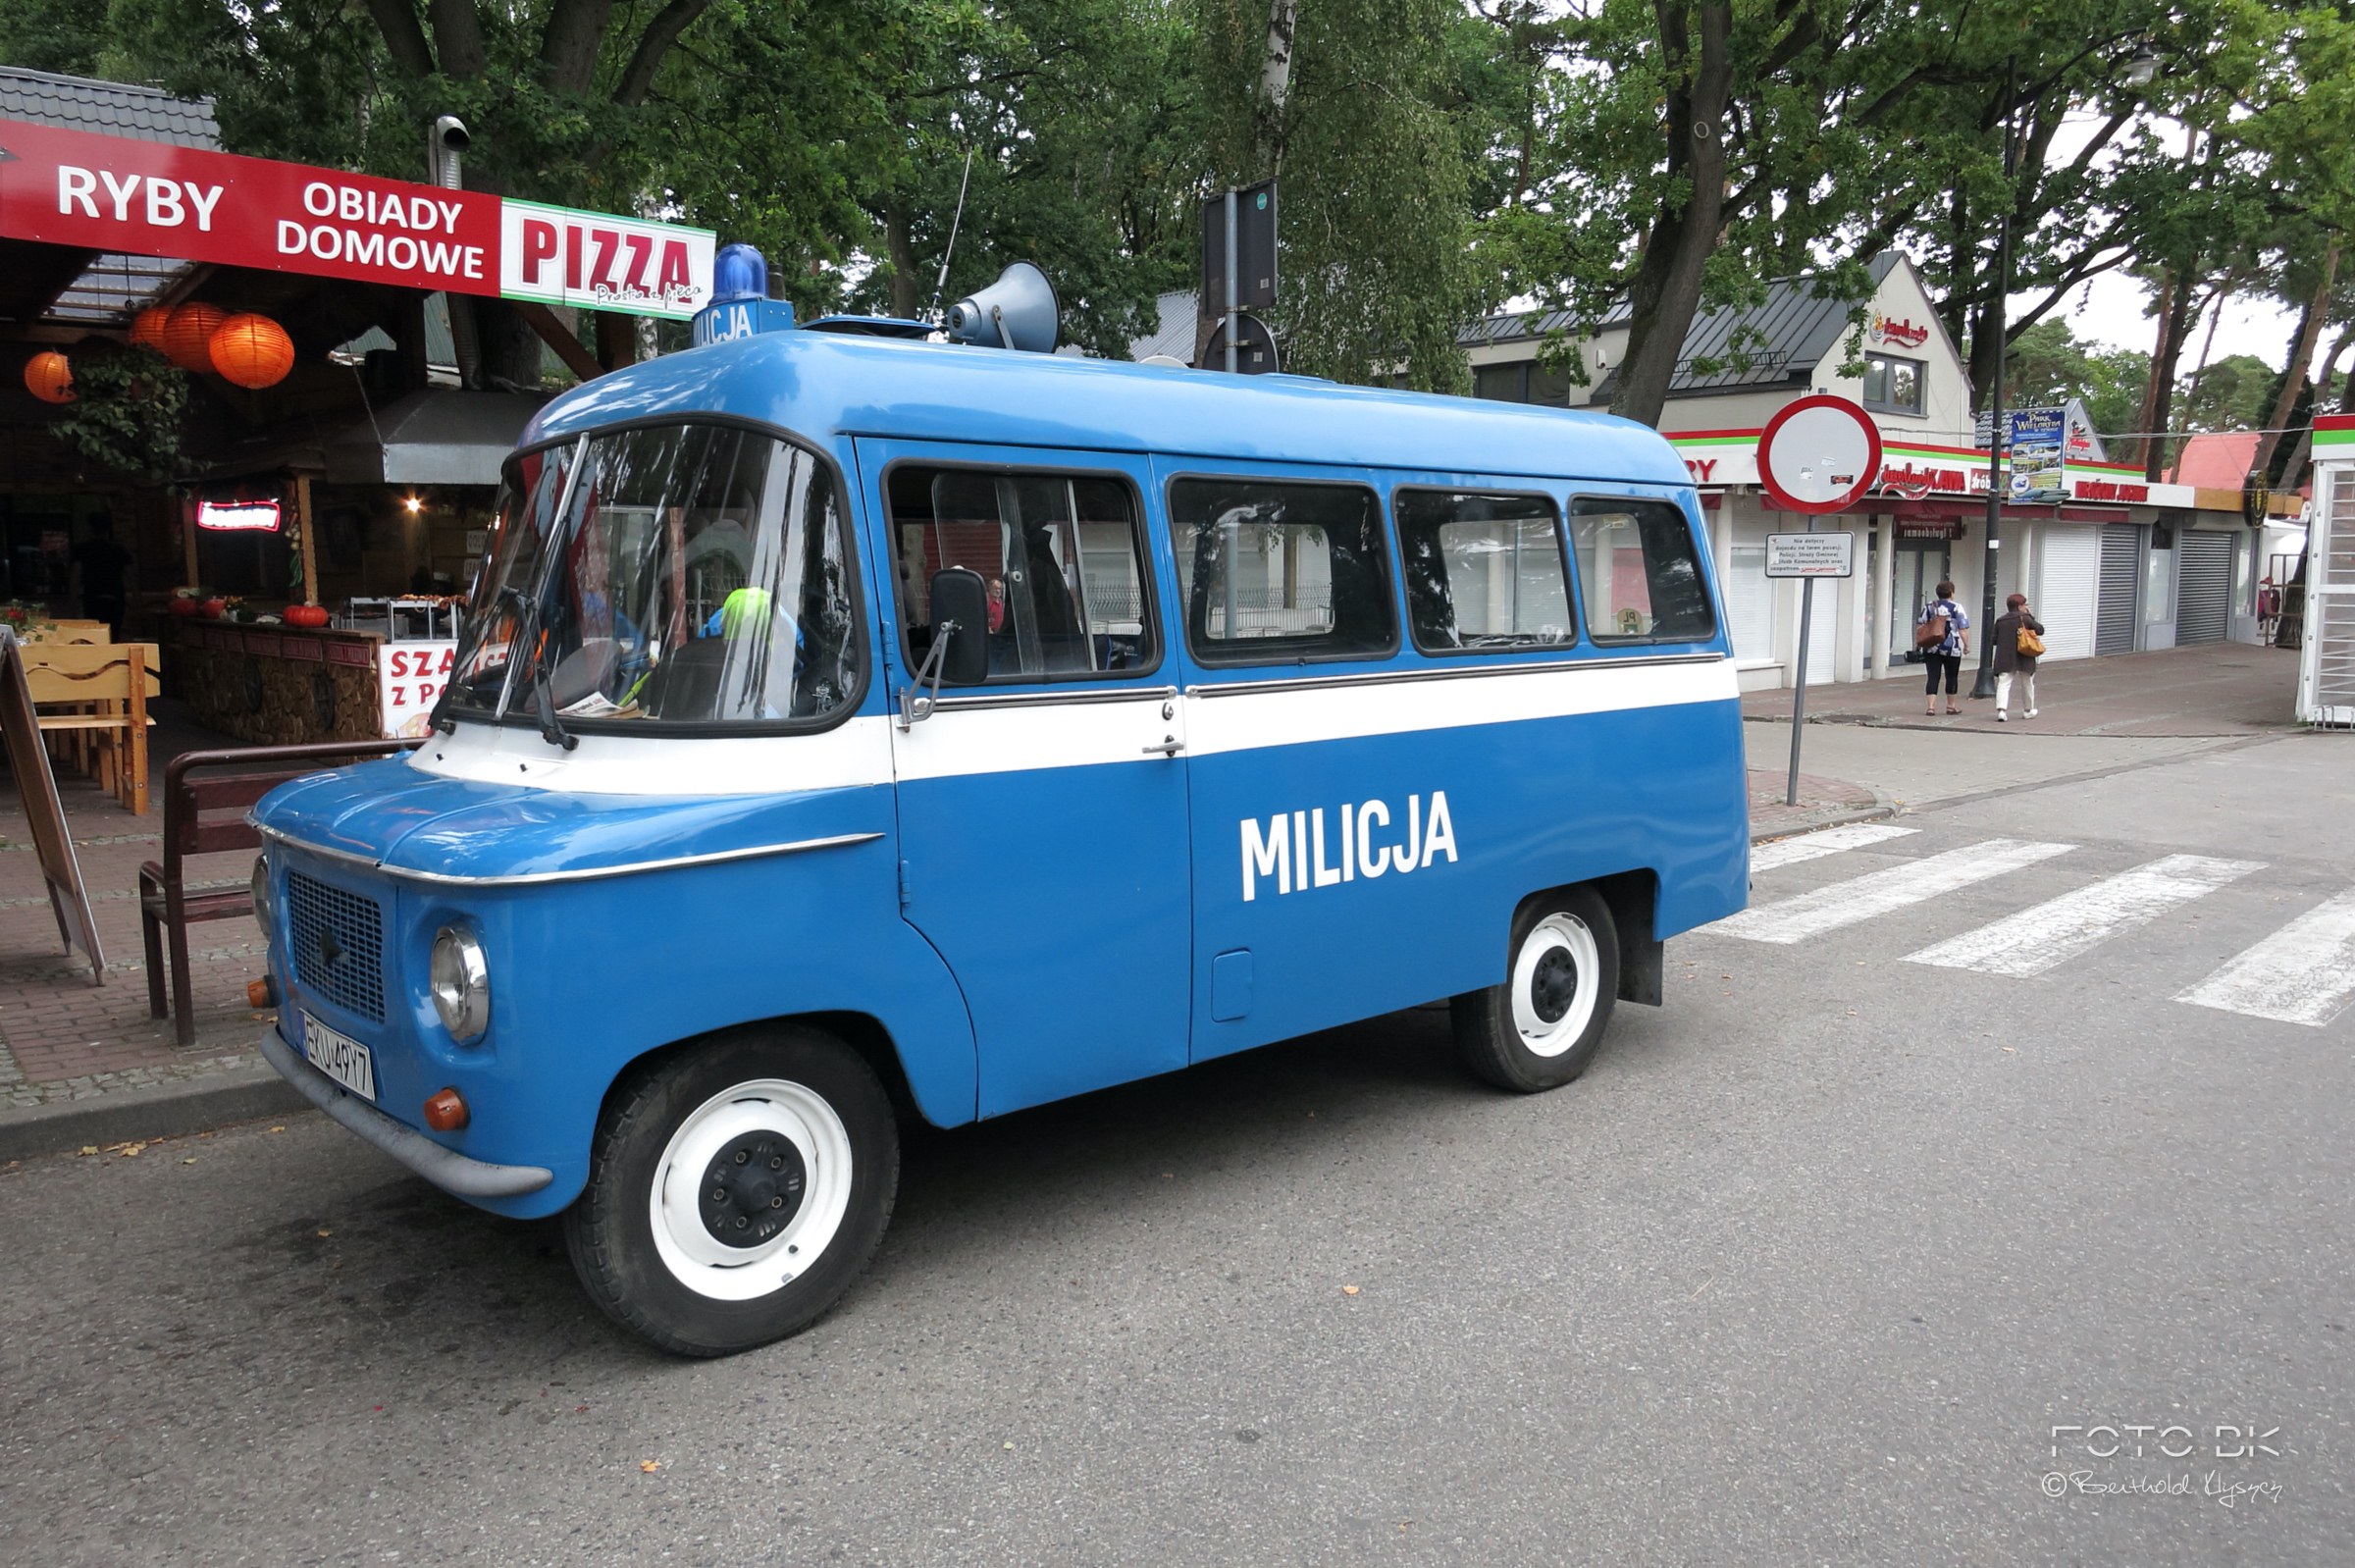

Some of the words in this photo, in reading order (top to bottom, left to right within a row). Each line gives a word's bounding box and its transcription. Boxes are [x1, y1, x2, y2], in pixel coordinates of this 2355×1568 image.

[58, 165, 225, 232] RYBY
[303, 182, 464, 235] OBIADY
[277, 219, 485, 280] DOMOWE
[522, 218, 693, 304] PIZZA
[597, 285, 646, 304] Prosto
[650, 289, 661, 299] z
[1240, 790, 1459, 903] MILICJA
[306, 1020, 331, 1070] EKU
[335, 1040, 367, 1091] 49Y7
